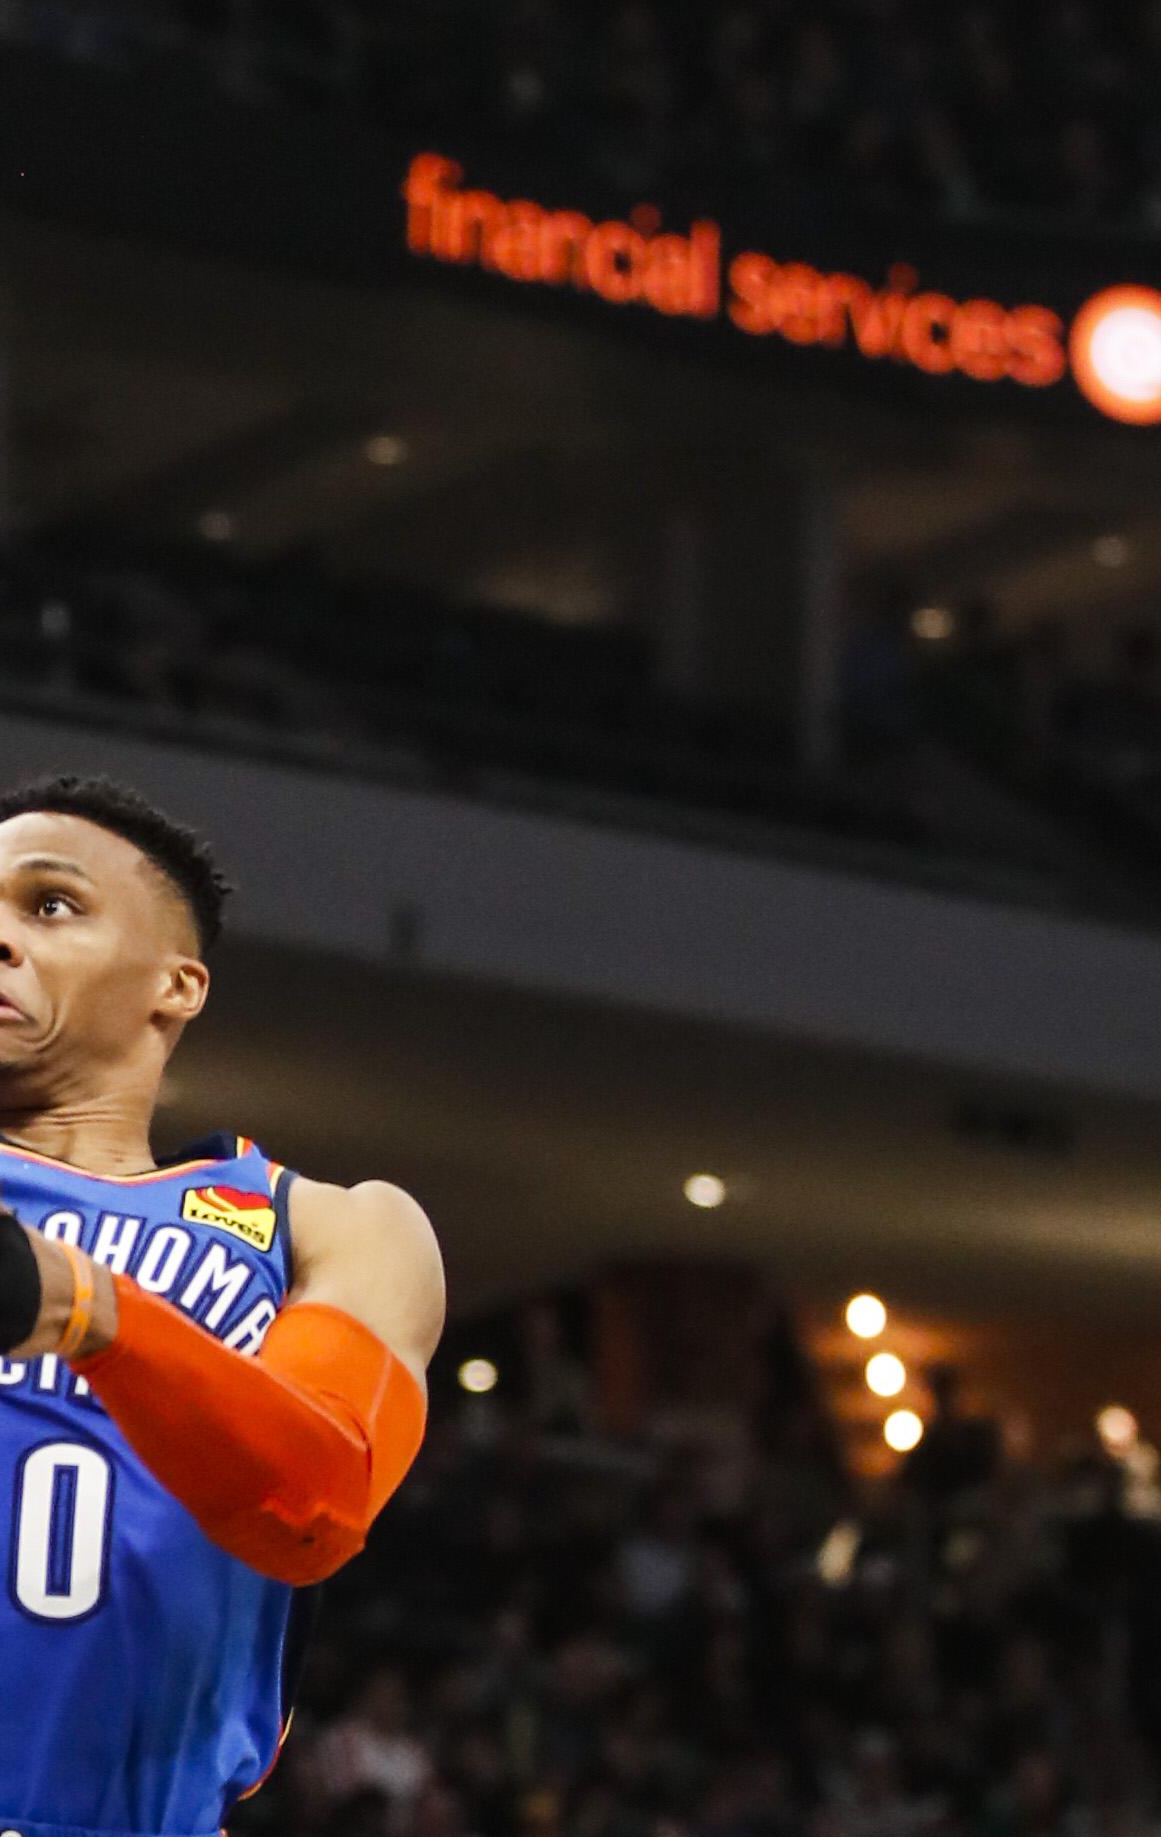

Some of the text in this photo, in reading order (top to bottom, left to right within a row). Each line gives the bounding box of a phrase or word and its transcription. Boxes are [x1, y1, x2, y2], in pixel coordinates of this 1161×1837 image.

[402, 152, 1066, 387] financial services
[15, 1440, 112, 1621] 0
